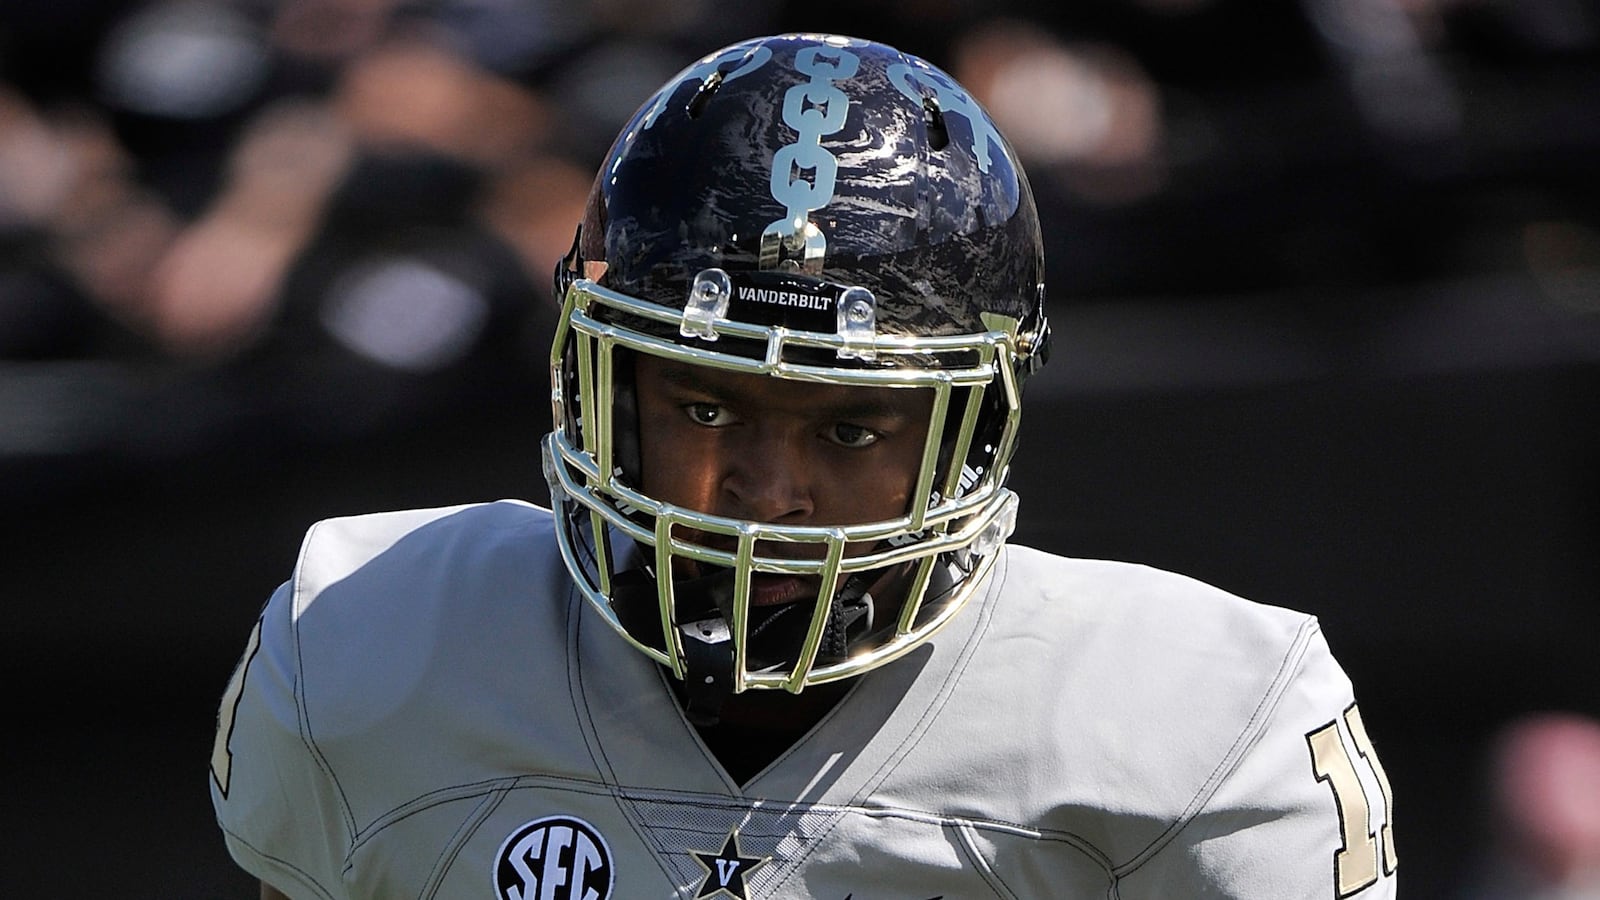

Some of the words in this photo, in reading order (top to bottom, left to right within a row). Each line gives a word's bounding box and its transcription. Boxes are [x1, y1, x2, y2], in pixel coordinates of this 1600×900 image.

[738, 286, 832, 311] VANDERBILT
[506, 825, 603, 900] SEC
[715, 858, 740, 887] V
